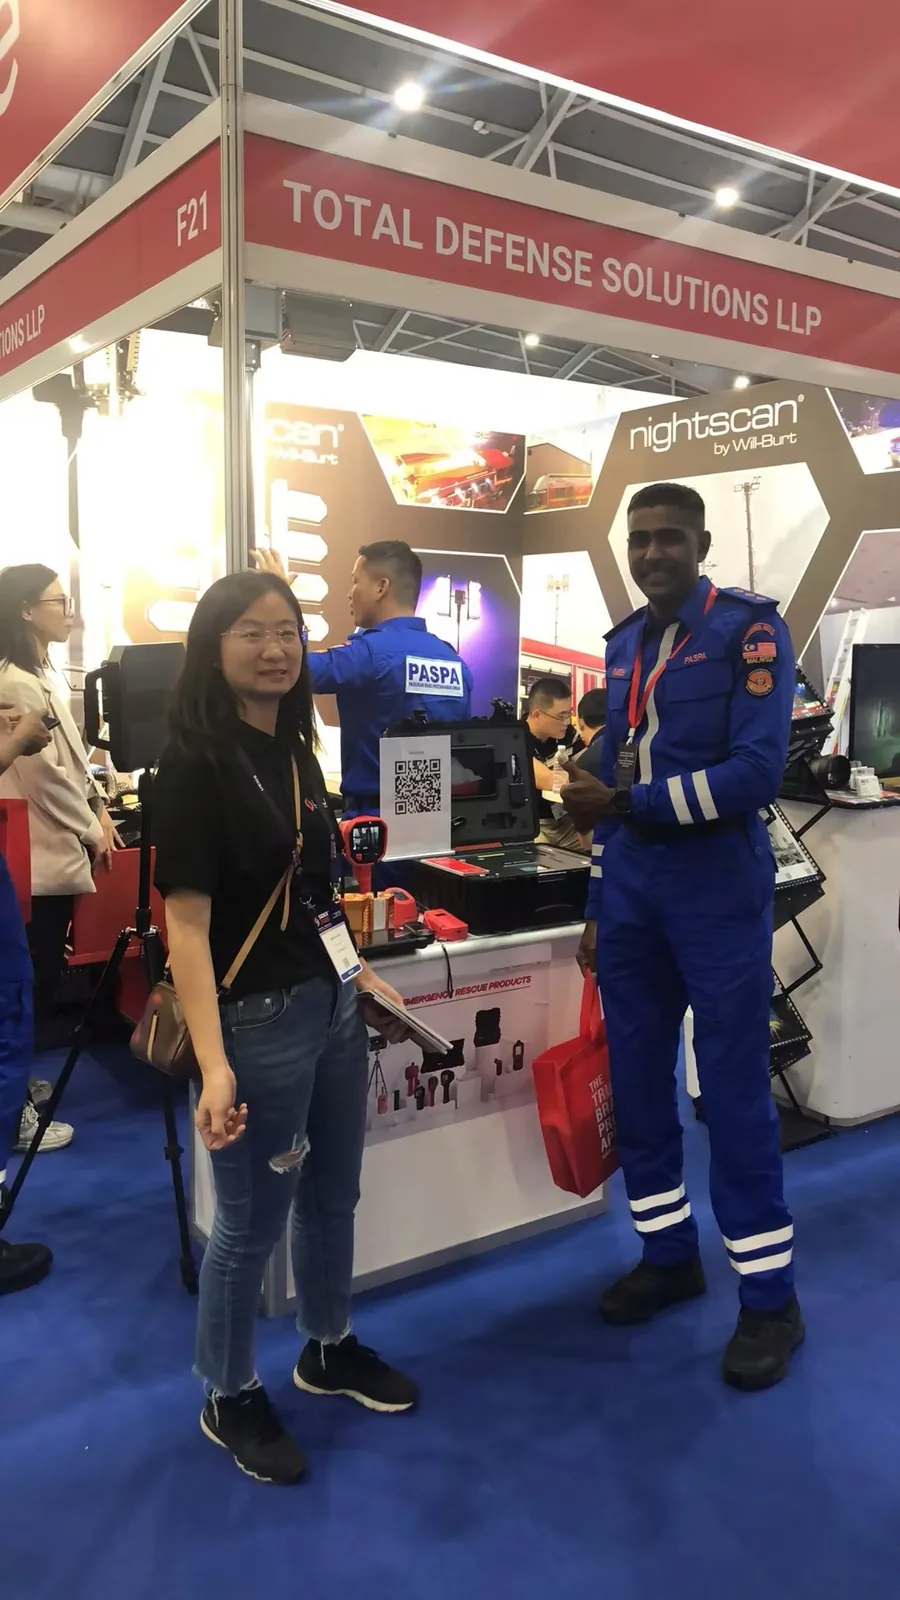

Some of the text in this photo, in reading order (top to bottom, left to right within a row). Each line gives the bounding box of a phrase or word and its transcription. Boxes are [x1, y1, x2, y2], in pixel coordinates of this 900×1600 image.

[177, 190, 207, 247] F21
[283, 179, 822, 336] TOTAL DEFENSE SOLUTIONS LLP
[26, 303, 45, 342] LLP
[629, 399, 798, 453] nightscan
[713, 442, 730, 457] by
[684, 652, 707, 665] PASPA
[408, 662, 460, 685] PASPA
[455, 983, 488, 997] RESCUE
[488, 975, 532, 990] PRODUCTS
[589, 1073, 604, 1092] THE
